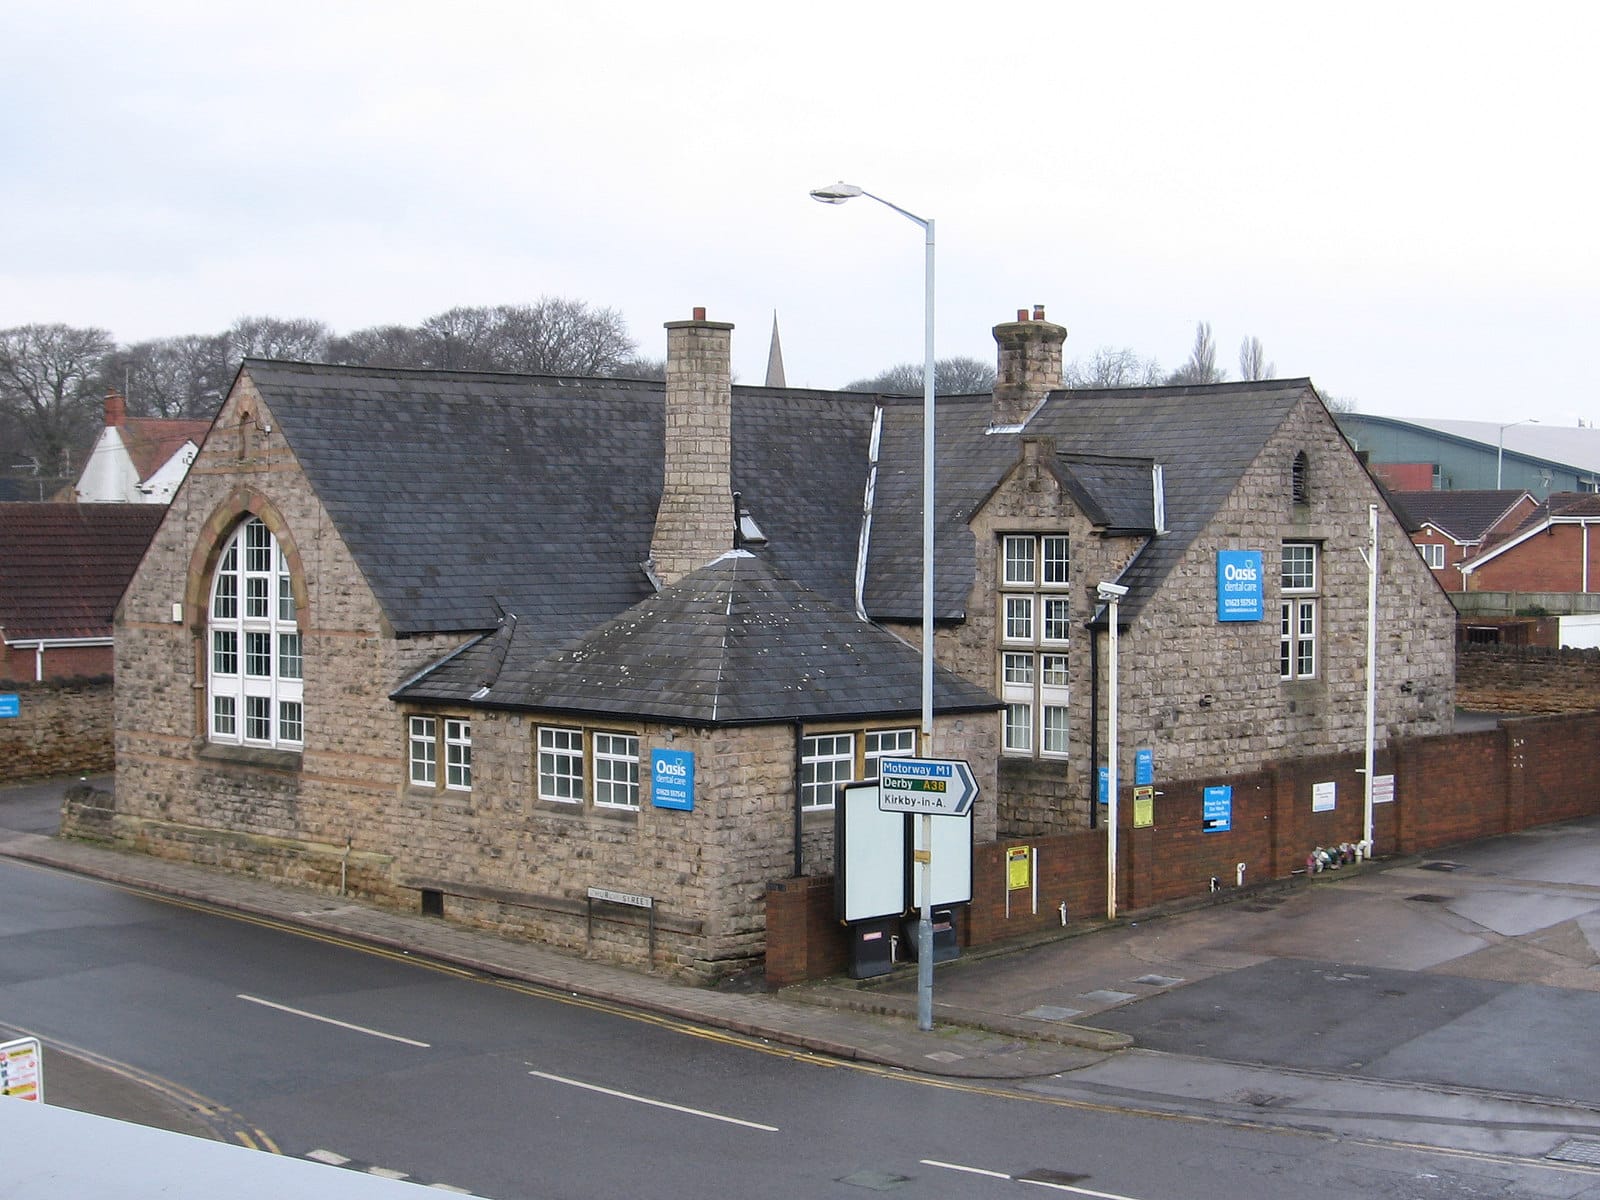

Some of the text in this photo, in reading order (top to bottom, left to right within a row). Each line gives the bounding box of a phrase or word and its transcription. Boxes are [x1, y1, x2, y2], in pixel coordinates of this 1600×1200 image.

[1225, 563, 1257, 581] Oasis
[1225, 581, 1257, 592] dental care
[656, 759, 686, 777] Oasis
[883, 762, 950, 776] Motorway M1
[656, 774, 687, 786] dental care
[884, 777, 945, 791] Derby A38
[884, 794, 947, 808] Kirkby-in-A.
